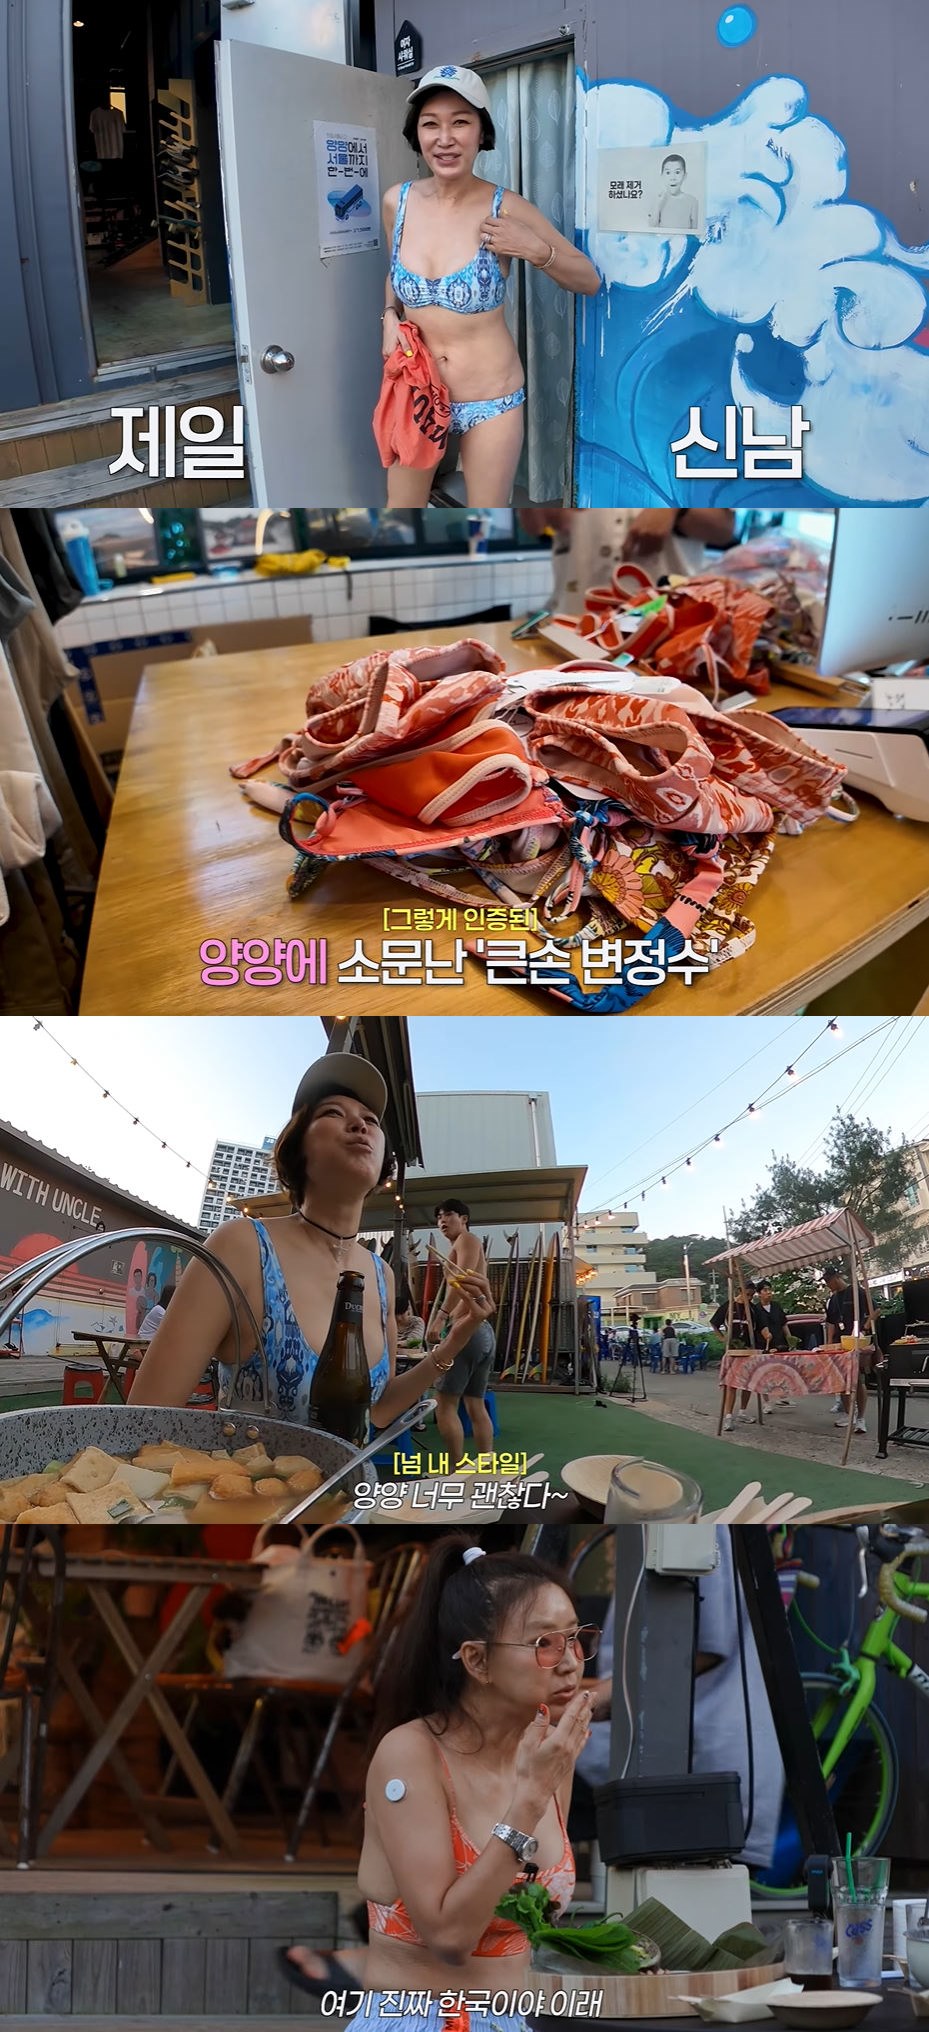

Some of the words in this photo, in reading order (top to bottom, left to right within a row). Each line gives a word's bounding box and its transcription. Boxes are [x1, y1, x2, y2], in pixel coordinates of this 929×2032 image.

[326, 139, 368, 154] 양양에서
[327, 152, 369, 166] 서울까지
[610, 180, 624, 190] 모래
[626, 180, 642, 190] 제거
[608, 190, 643, 199] 하셨나요?
[0, 1162, 50, 1206] WITH
[52, 1188, 102, 1228] UNCLE
